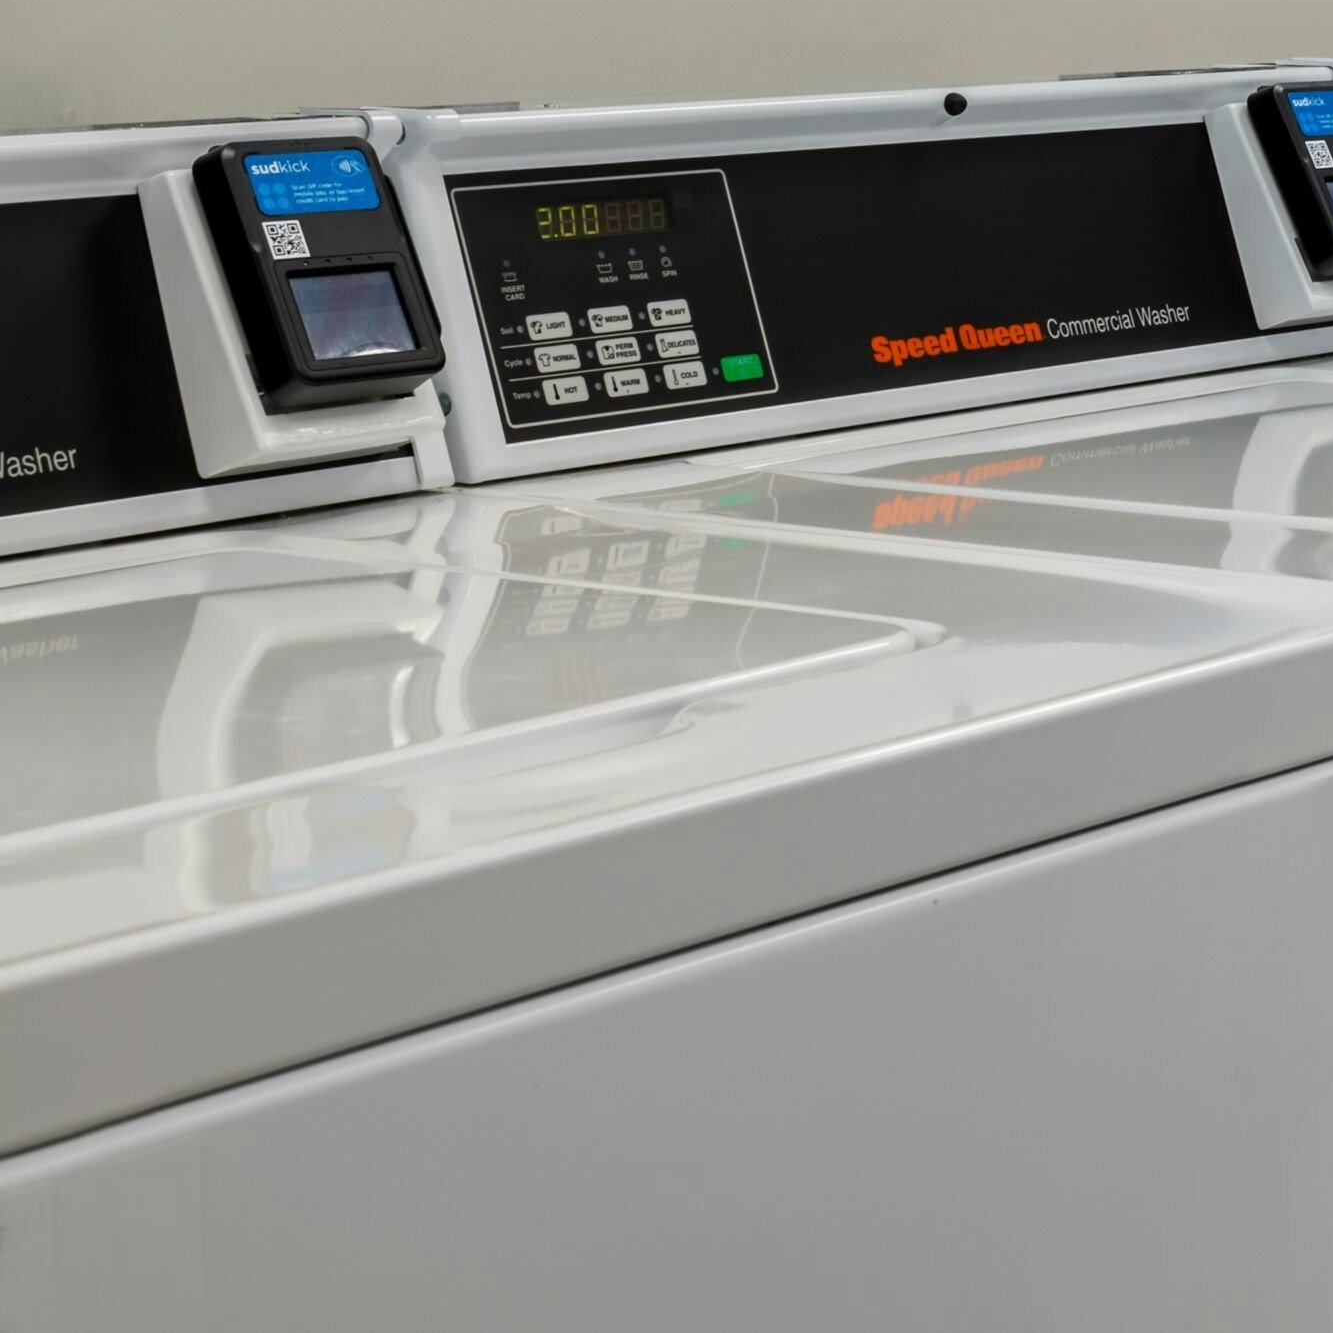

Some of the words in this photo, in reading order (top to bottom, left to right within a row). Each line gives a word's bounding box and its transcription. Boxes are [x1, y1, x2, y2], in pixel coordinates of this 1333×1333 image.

[1292, 96, 1326, 107] sudkick
[251, 160, 311, 175] sudkick
[537, 204, 600, 239] 2.00
[629, 272, 650, 281] RINSE
[661, 269, 678, 278] SPIN
[599, 275, 619, 284] WASH
[501, 284, 525, 294] INSERT
[505, 293, 526, 302] CARD
[665, 307, 687, 317] HEAVY
[604, 314, 629, 324] MEDIUM
[545, 321, 566, 330] LIGHT
[870, 327, 958, 366] Speed
[960, 320, 1045, 350] Queen
[1046, 308, 1136, 340] Commercial
[1135, 302, 1190, 327] Washer
[615, 342, 634, 350] PERM
[667, 338, 697, 349] DELICATES
[552, 353, 577, 363] NORMAL
[616, 350, 638, 359] PRESS
[504, 359, 524, 369] Cycle
[680, 370, 699, 379] COLD
[620, 378, 642, 387] WARM
[564, 386, 578, 394] HOT
[513, 392, 532, 401] Temp
[0, 447, 77, 479] asher
